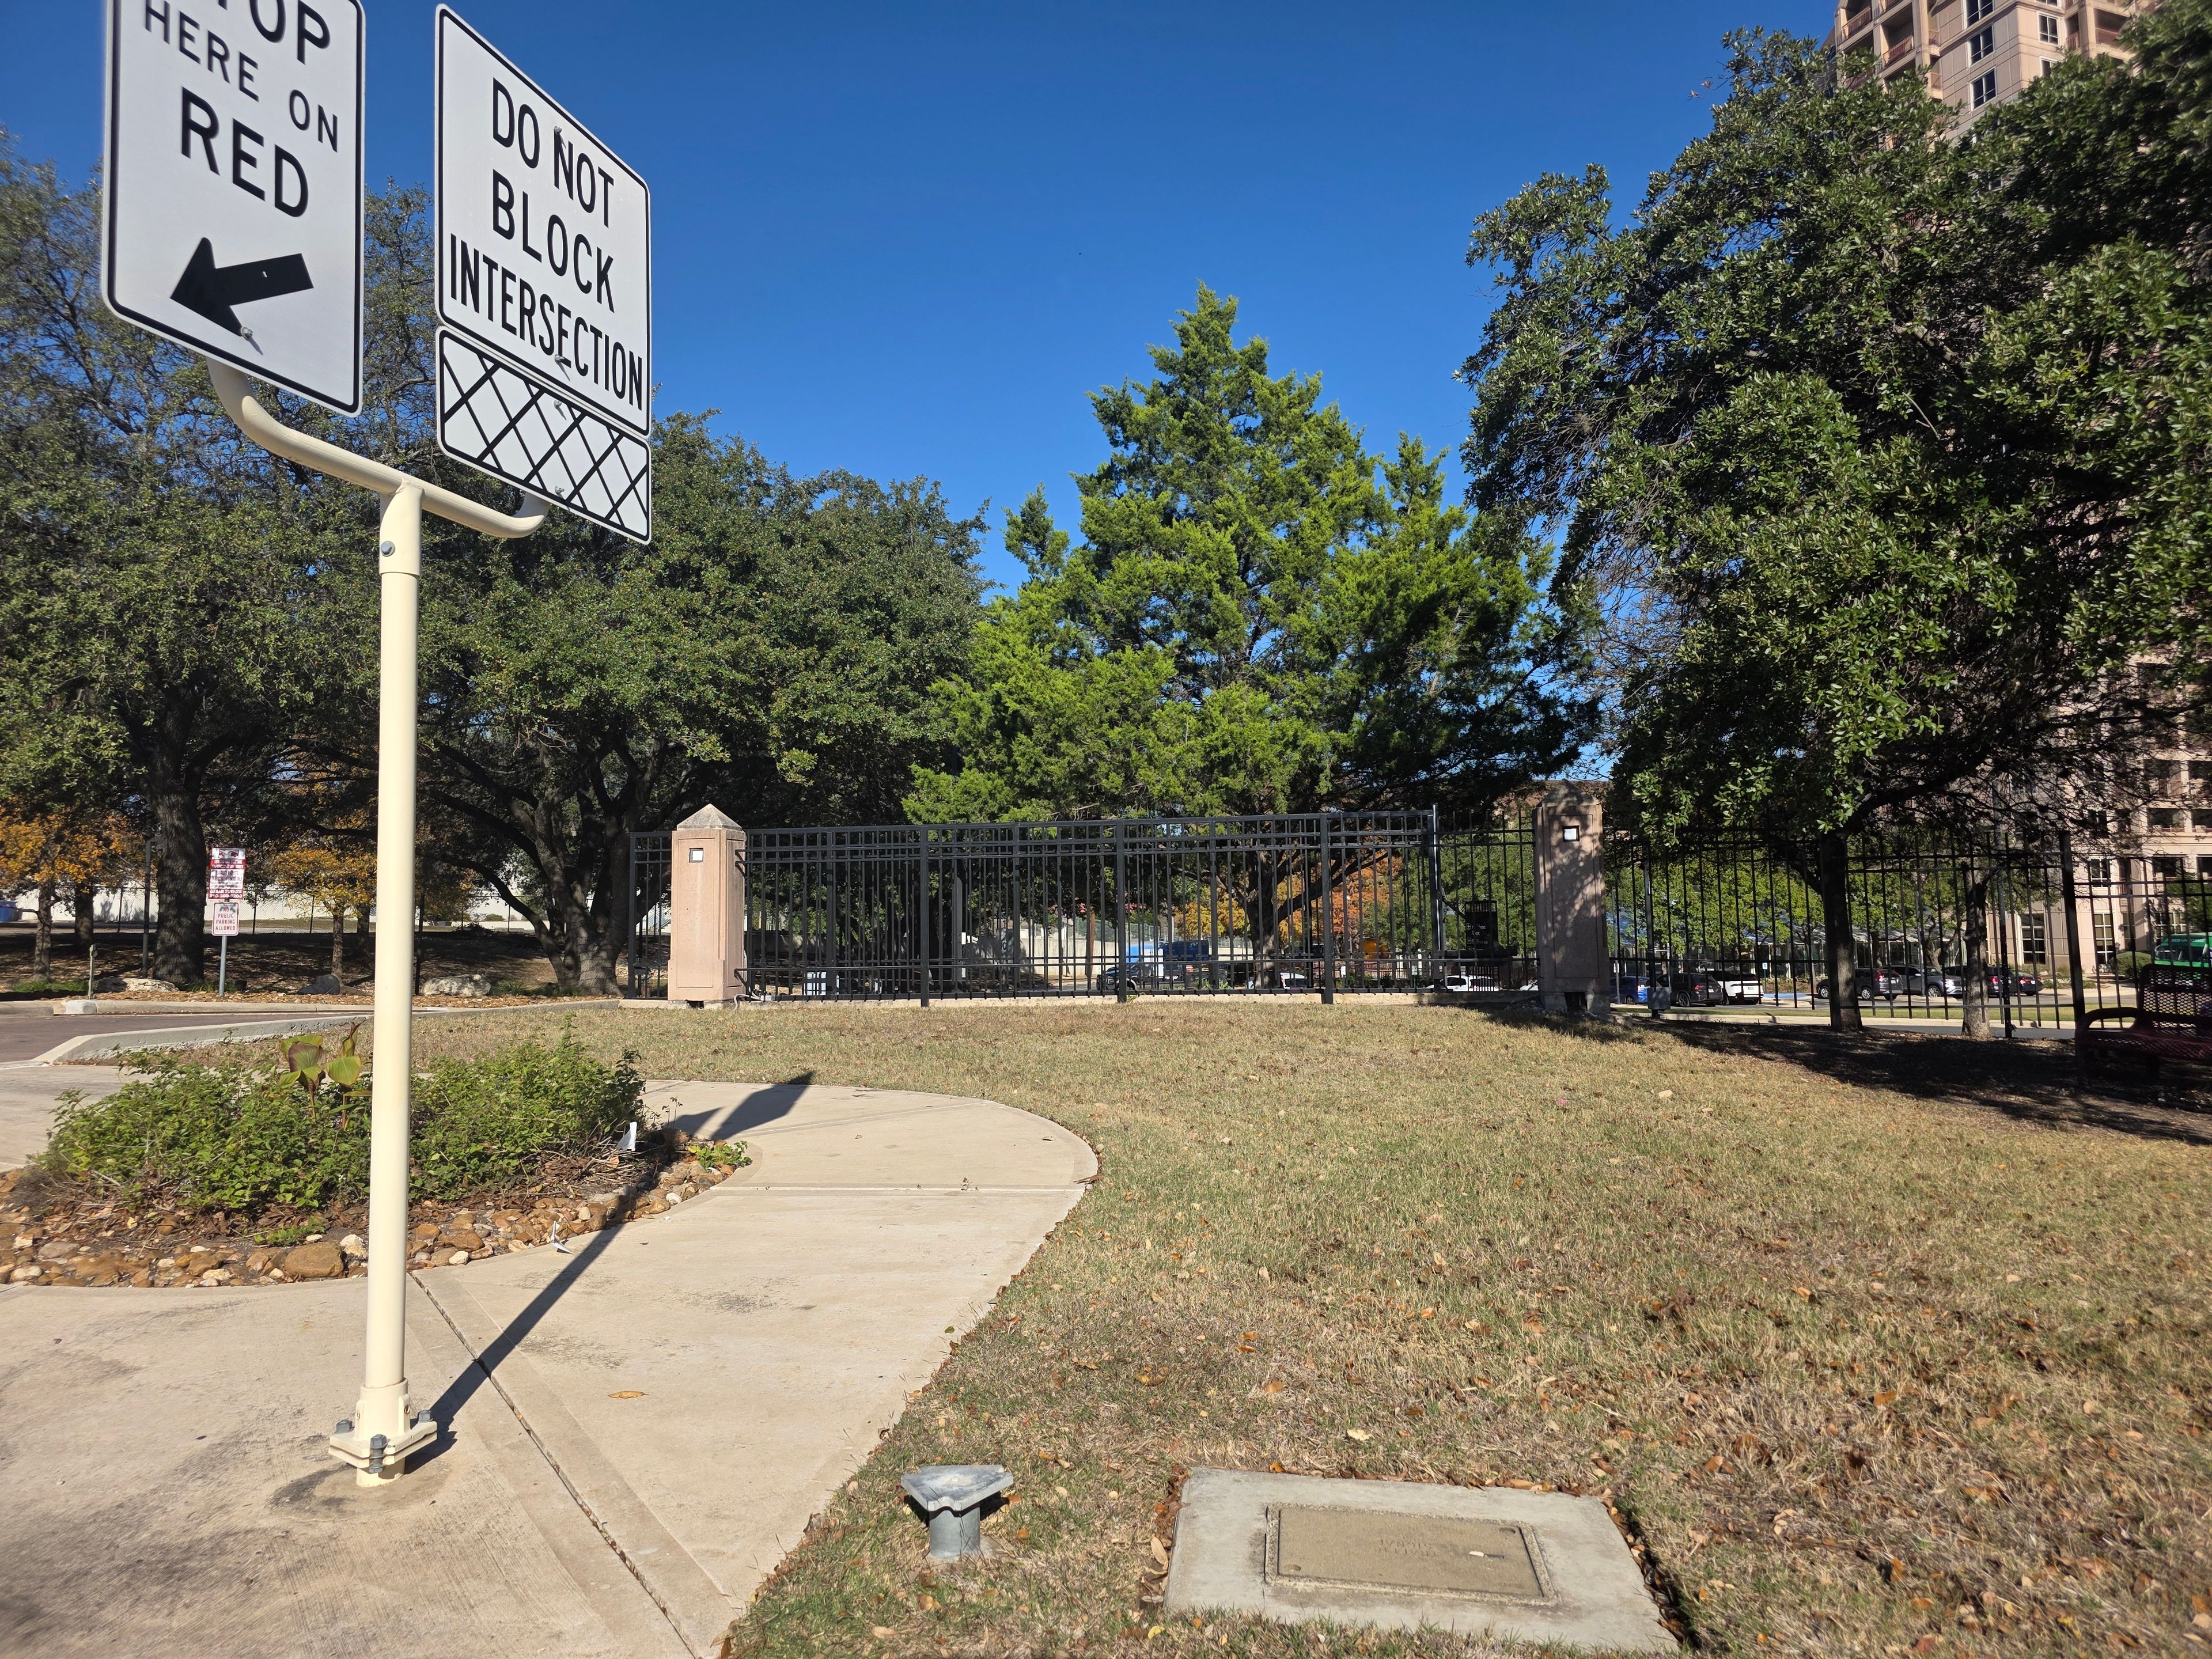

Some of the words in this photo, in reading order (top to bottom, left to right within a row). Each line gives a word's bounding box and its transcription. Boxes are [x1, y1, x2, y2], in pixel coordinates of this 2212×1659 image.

[145, 0, 259, 103] HERE
[288, 89, 338, 153] ON
[180, 86, 309, 218] RED
[493, 77, 540, 169] DO
[554, 129, 615, 228] NOT
[493, 169, 615, 313] BLOCK
[450, 233, 643, 411] INTERSECTION
